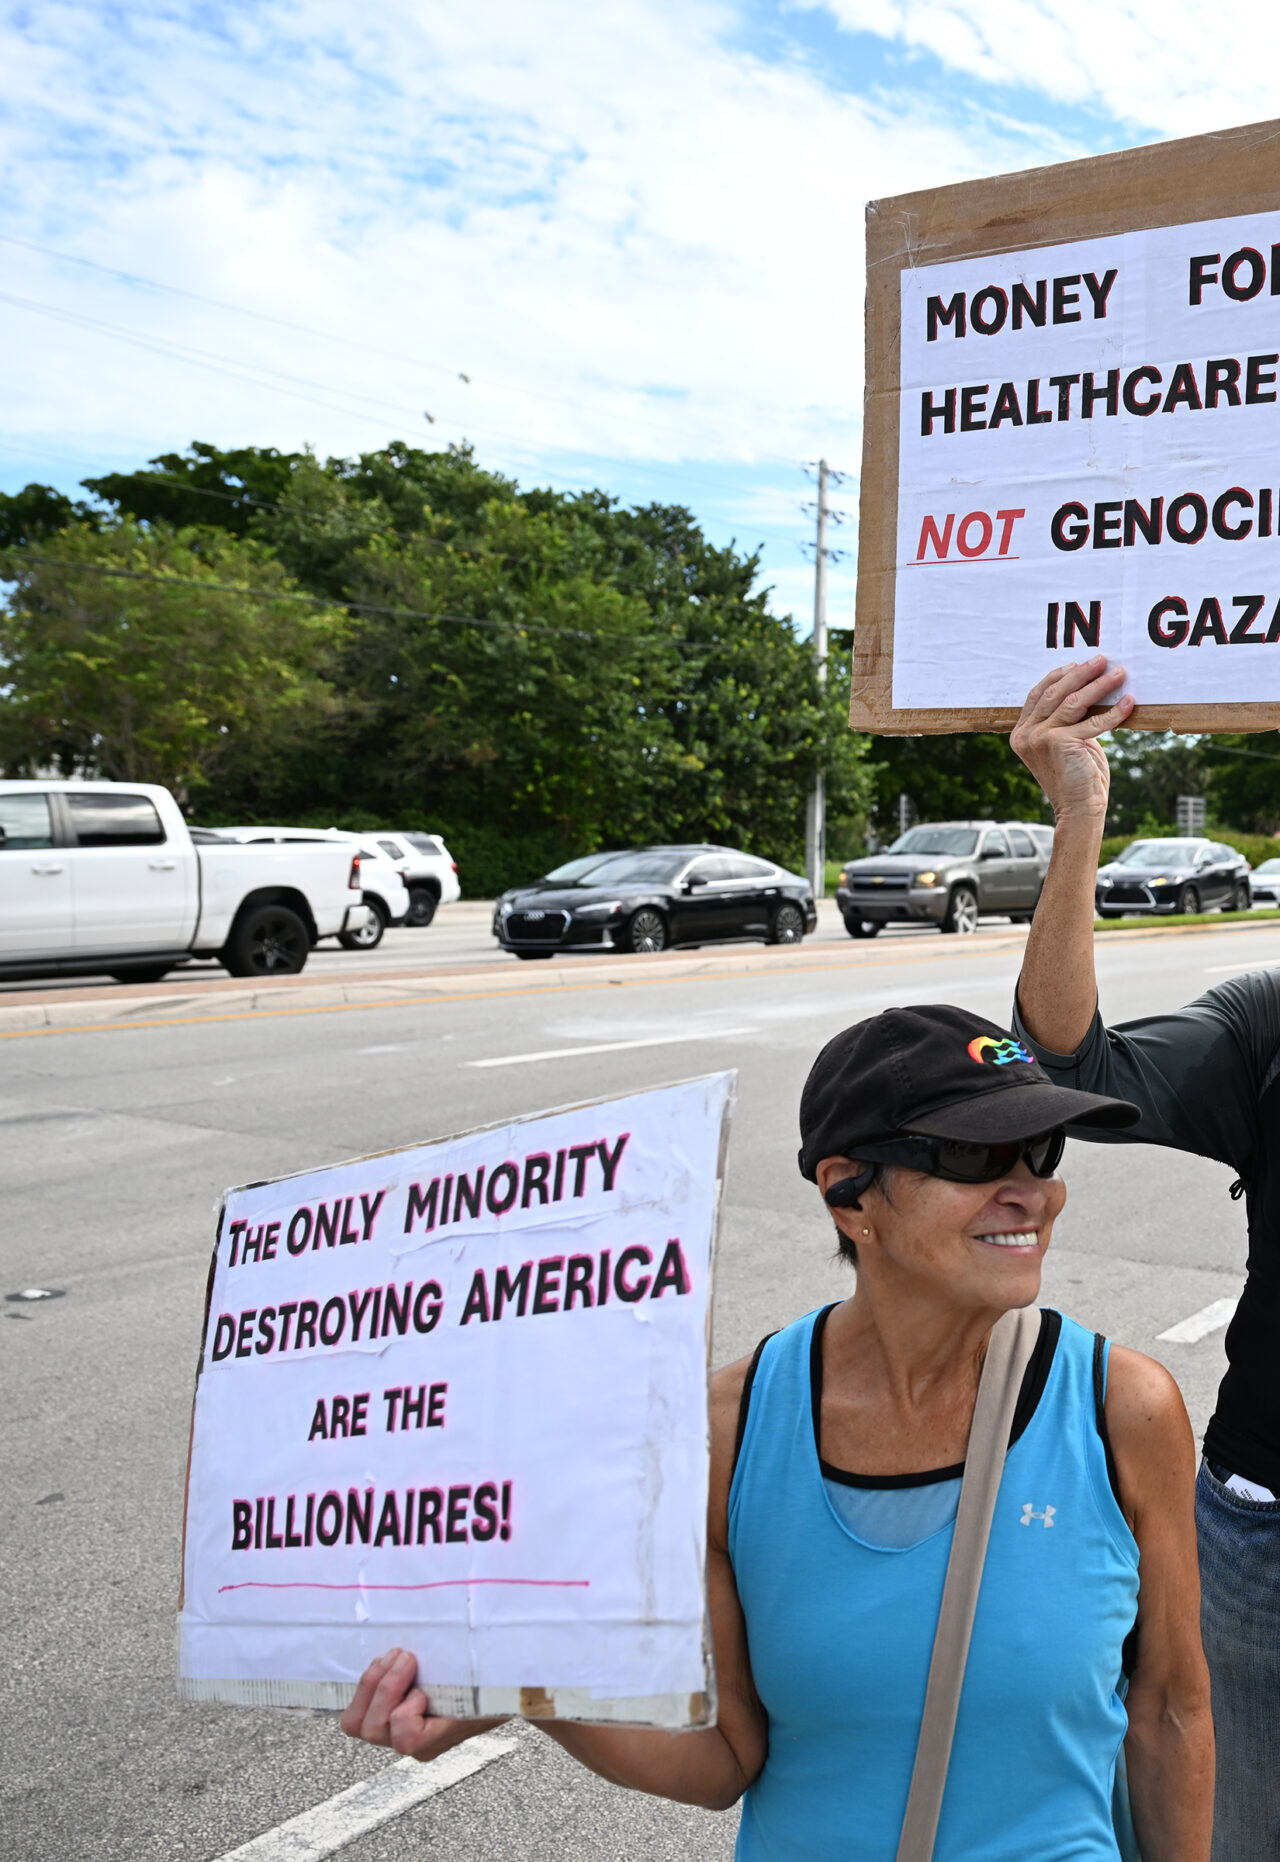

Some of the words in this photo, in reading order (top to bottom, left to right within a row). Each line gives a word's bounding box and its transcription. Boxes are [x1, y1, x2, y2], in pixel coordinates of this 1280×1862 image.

[926, 268, 1118, 342] MONEY
[921, 354, 1279, 436] HEALTHCARE
[916, 508, 1025, 560] NOT
[1046, 601, 1101, 649] IN
[228, 1218, 281, 1267] THE
[286, 1190, 386, 1257] ONLY
[403, 1132, 631, 1234] MINORITY
[212, 1280, 444, 1362] DESTROYING
[459, 1238, 691, 1326] AMERICA
[308, 1391, 370, 1442] ARE
[384, 1382, 448, 1434] THE
[231, 1480, 513, 1552] BILLIONAIRES!
